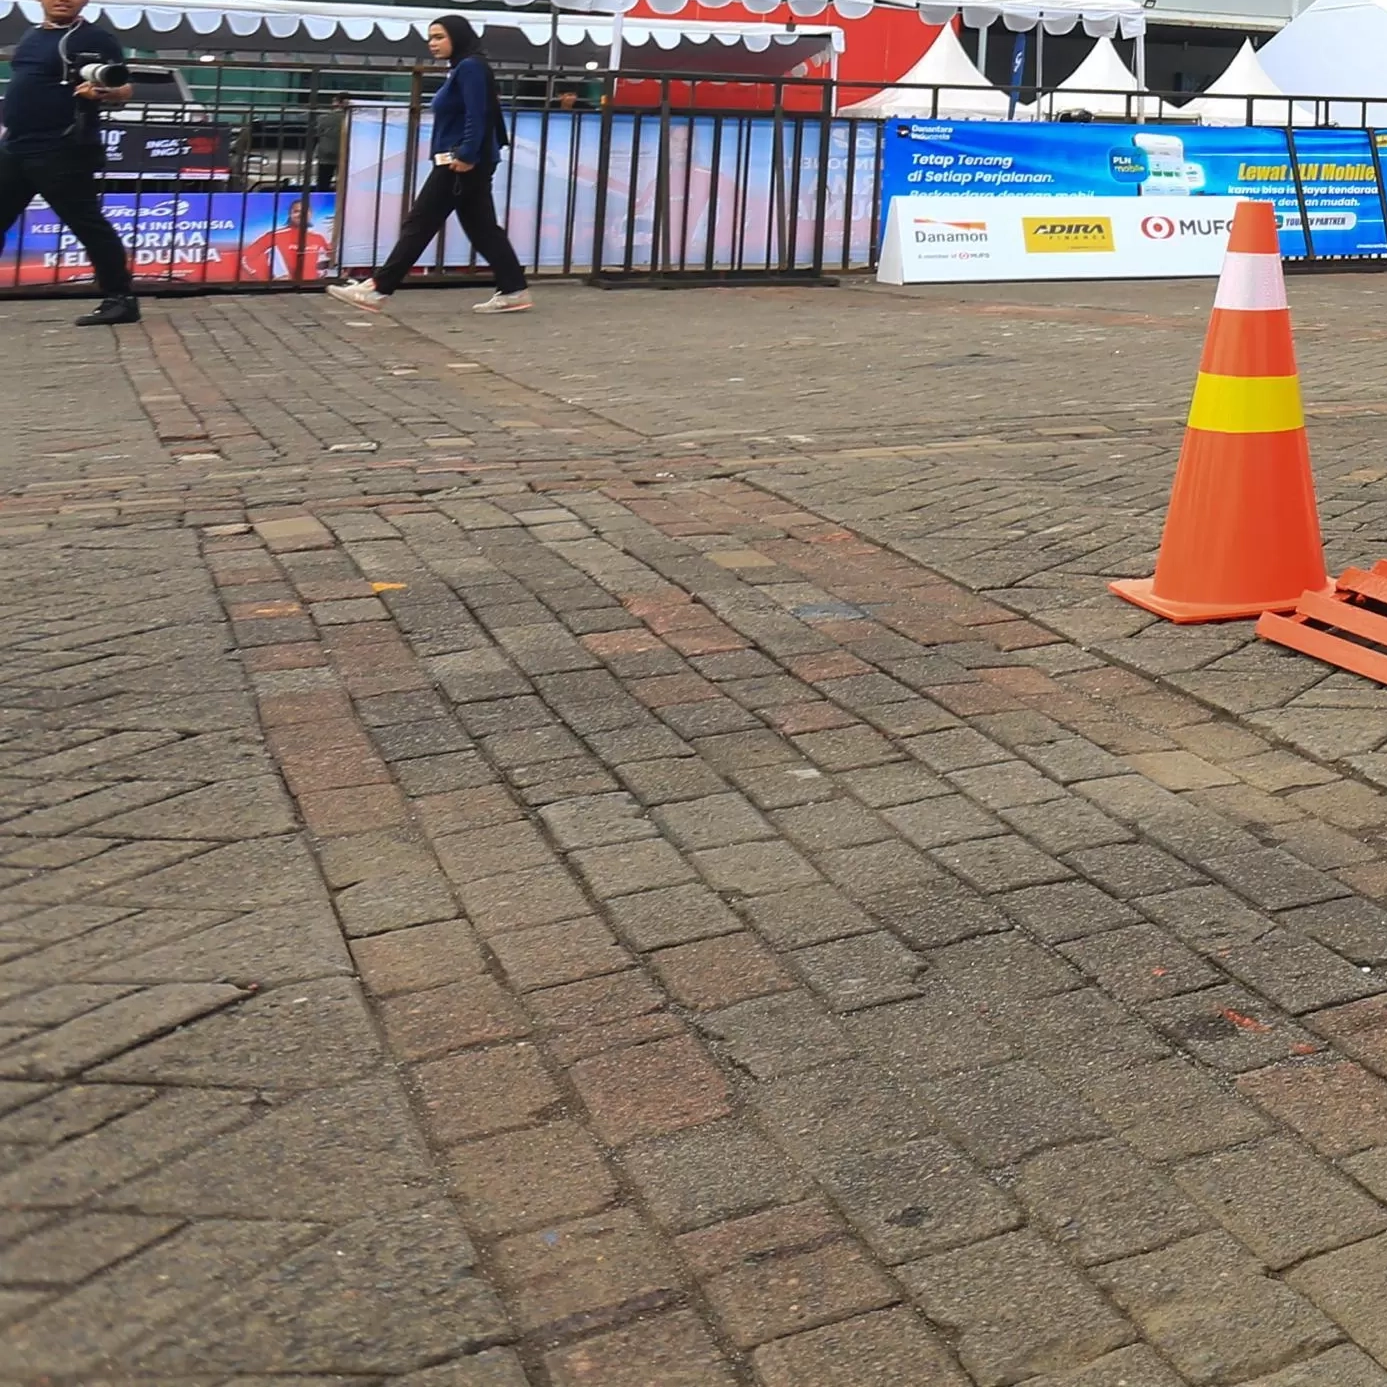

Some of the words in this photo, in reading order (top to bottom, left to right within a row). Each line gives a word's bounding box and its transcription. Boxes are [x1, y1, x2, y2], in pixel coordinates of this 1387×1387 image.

[912, 153, 952, 167] Tetap
[957, 154, 1013, 168] Tenang
[1112, 156, 1132, 165] PLN
[907, 171, 922, 183] di
[924, 171, 972, 185] Setiap
[974, 171, 1056, 186] Perjalanan.
[1238, 163, 1287, 181] Lewat
[1321, 164, 1377, 183] Mobile,
[1228, 185, 1260, 195] kamu
[1261, 185, 1285, 195] bisa
[1328, 185, 1379, 195] kendaraa
[1278, 197, 1318, 208] denan
[1320, 197, 1361, 207] mudah.
[1032, 223, 1105, 235] ADIRA
[914, 230, 988, 243] Danamon
[135, 248, 222, 265] DUNIA
